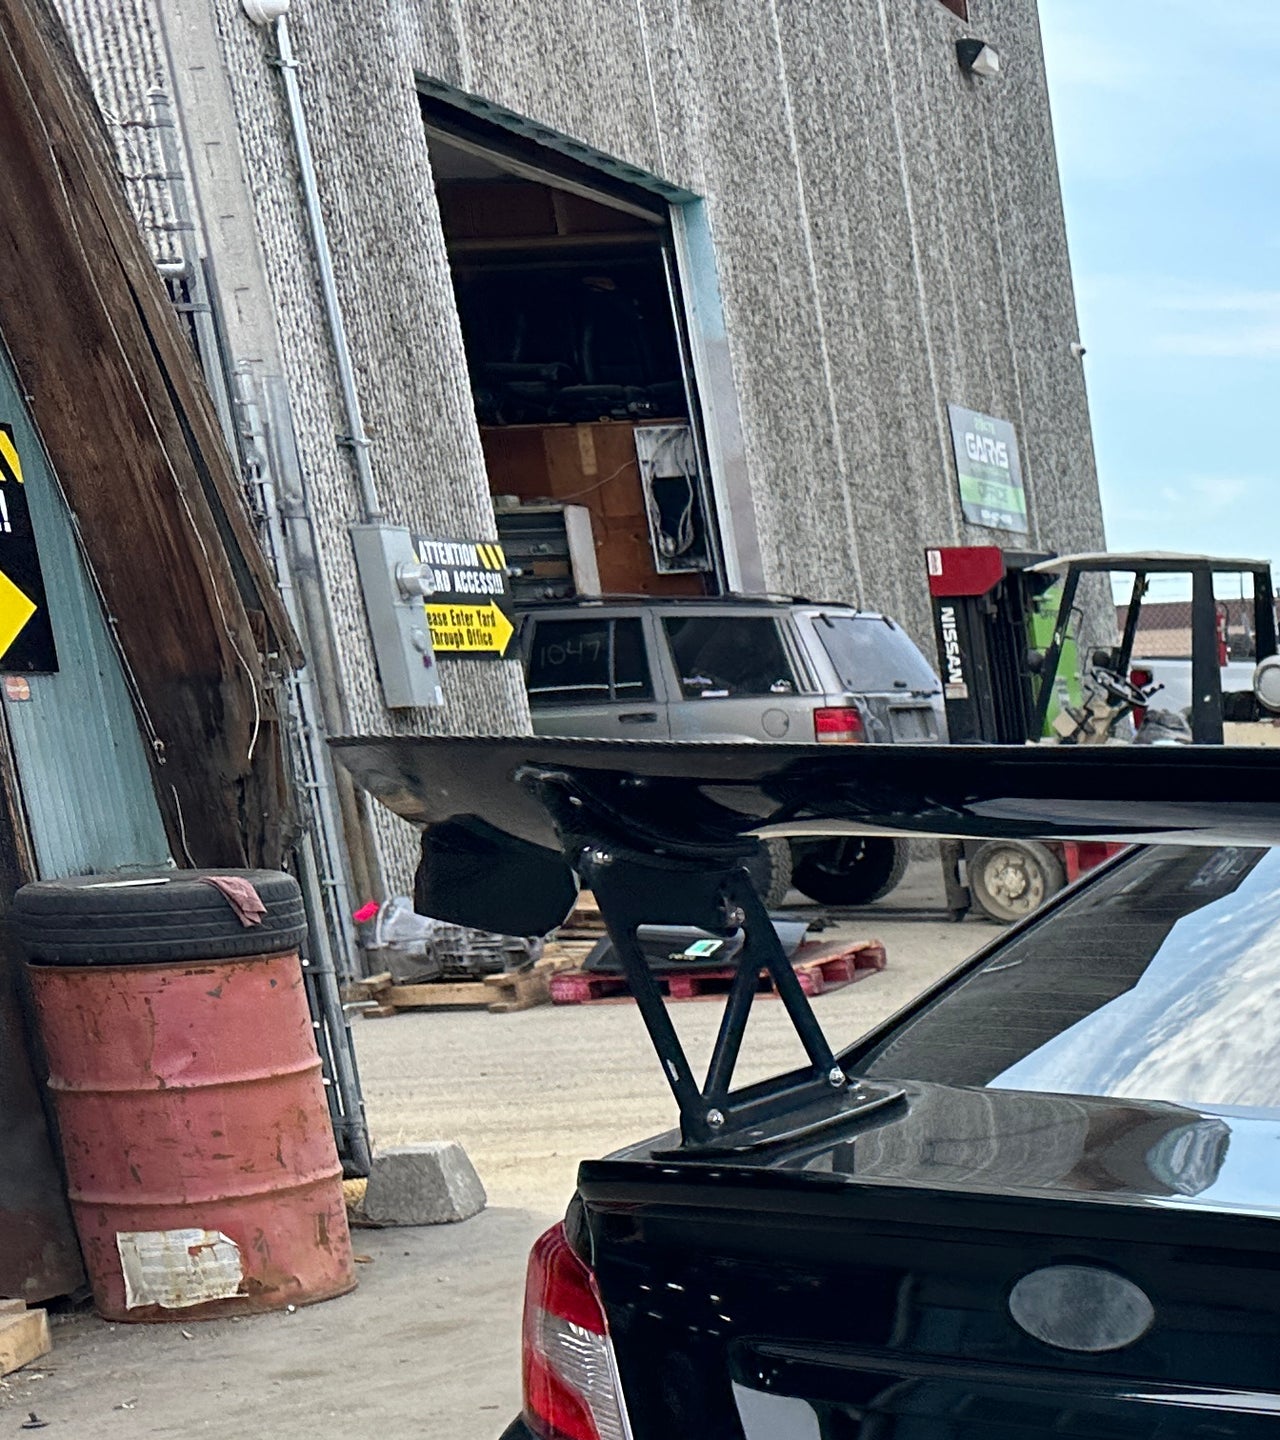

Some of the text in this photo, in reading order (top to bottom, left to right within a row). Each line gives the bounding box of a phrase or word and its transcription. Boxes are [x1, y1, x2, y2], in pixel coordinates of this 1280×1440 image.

[418, 540, 479, 567] ATTENTION
[453, 570, 504, 594] ACCESS!!!
[427, 609, 496, 627] ease Enter Yard
[429, 628, 494, 649] Through Office
[941, 607, 963, 683] NISSAN
